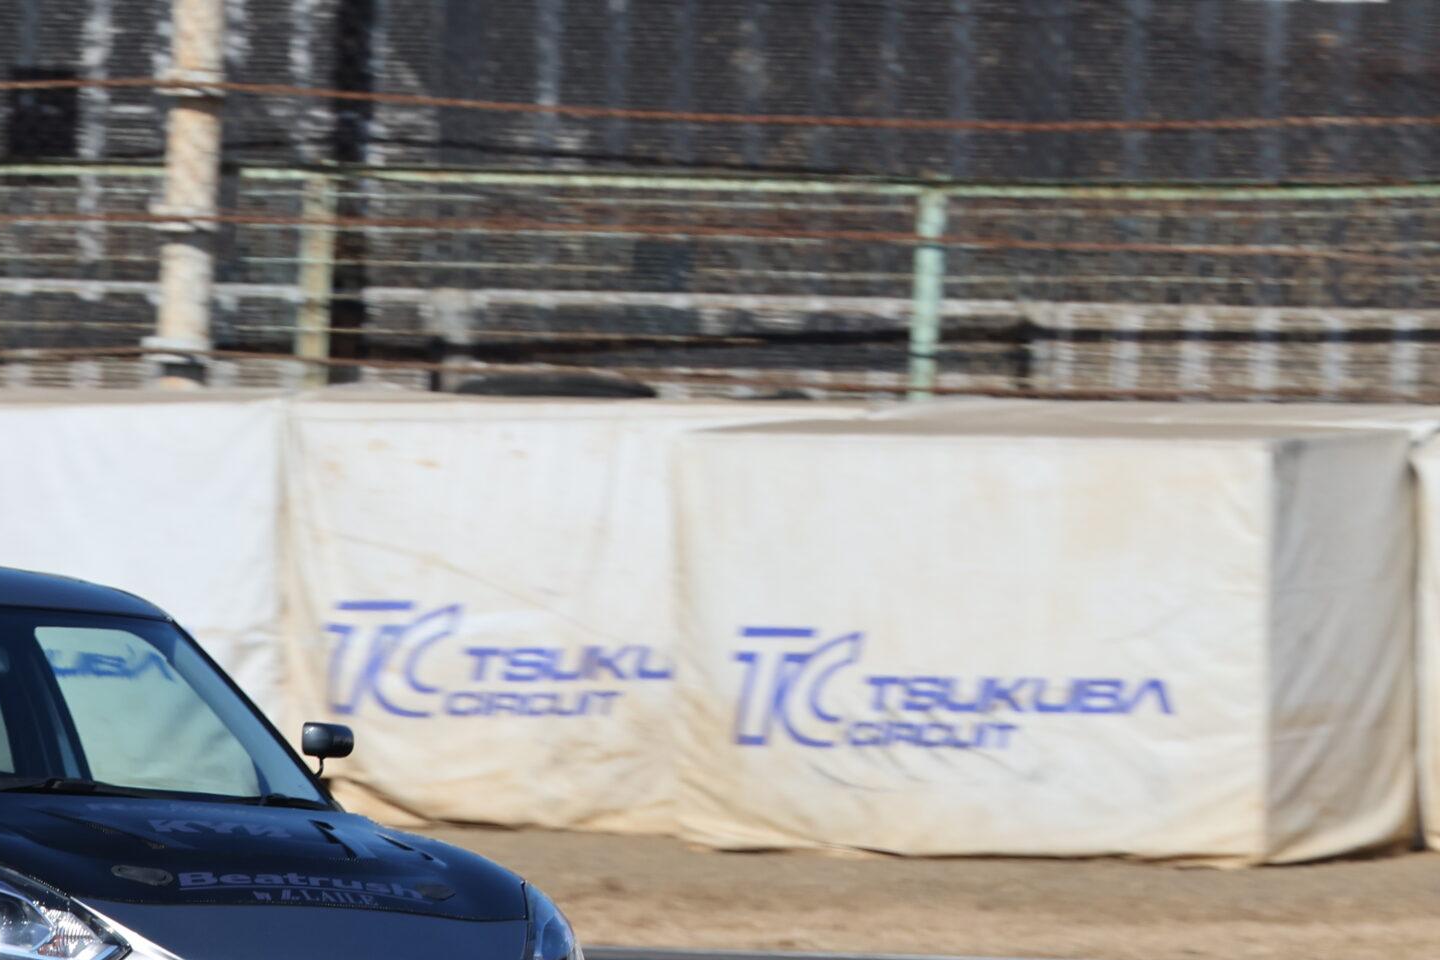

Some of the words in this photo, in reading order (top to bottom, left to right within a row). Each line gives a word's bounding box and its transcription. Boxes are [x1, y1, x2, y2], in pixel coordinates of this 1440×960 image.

[444, 691, 622, 718] CIRCUIT
[865, 675, 1174, 714] TSUKUBA
[846, 721, 1017, 748] CIRCUIT
[177, 870, 424, 901] Beatrush
